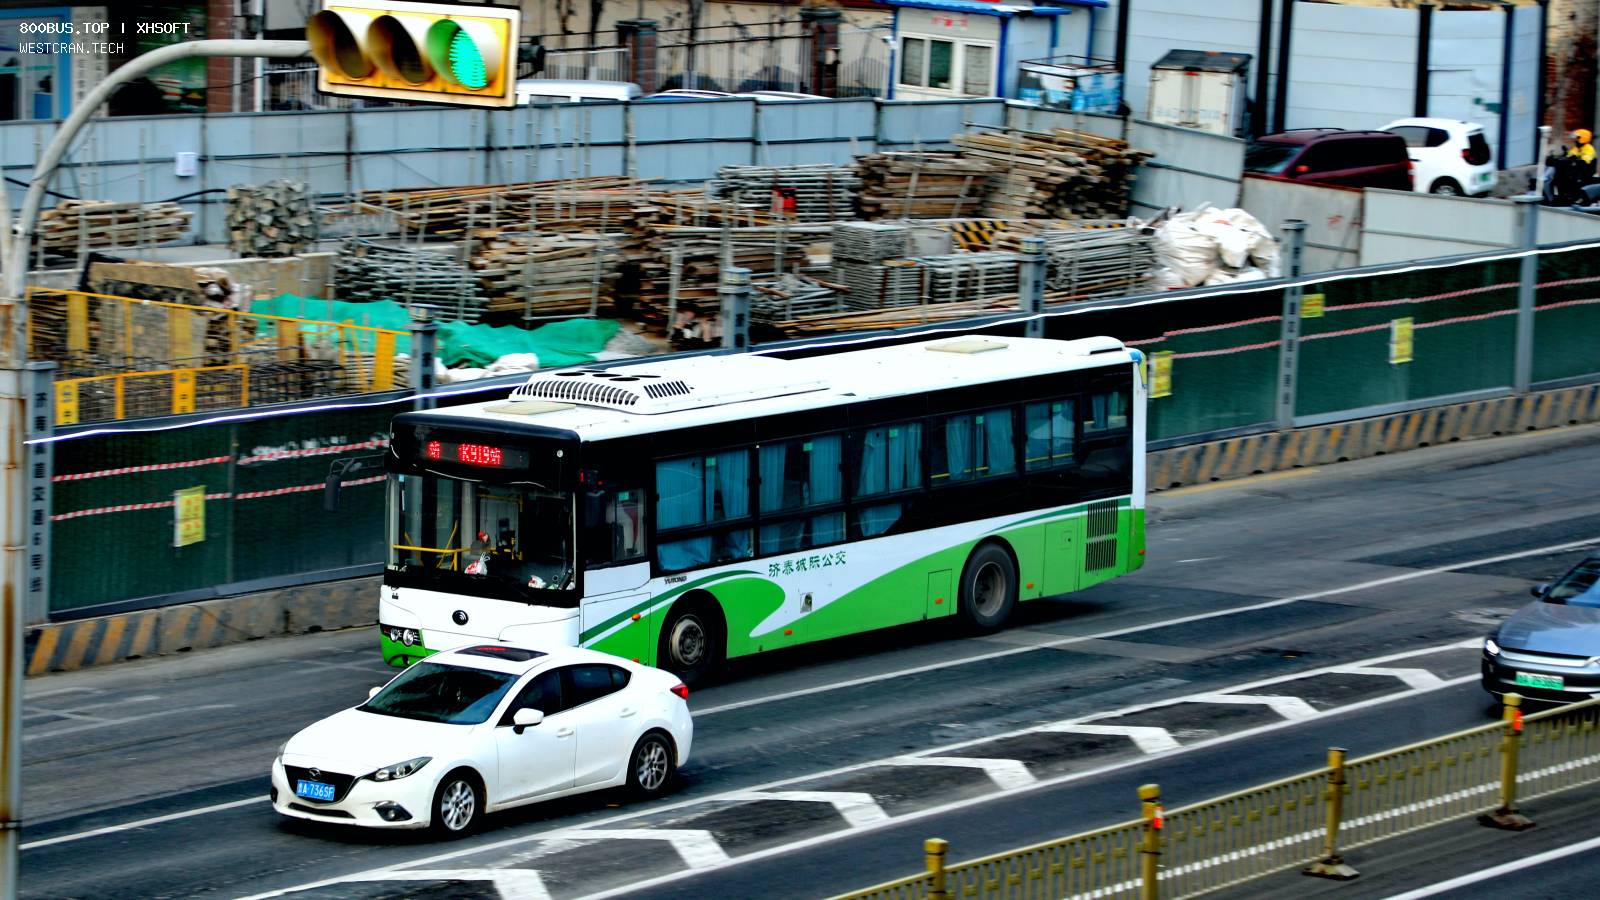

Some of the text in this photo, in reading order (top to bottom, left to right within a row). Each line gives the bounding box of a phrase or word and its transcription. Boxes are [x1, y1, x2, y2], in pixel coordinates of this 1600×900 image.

[768, 550, 847, 578] 济泰城际公交
